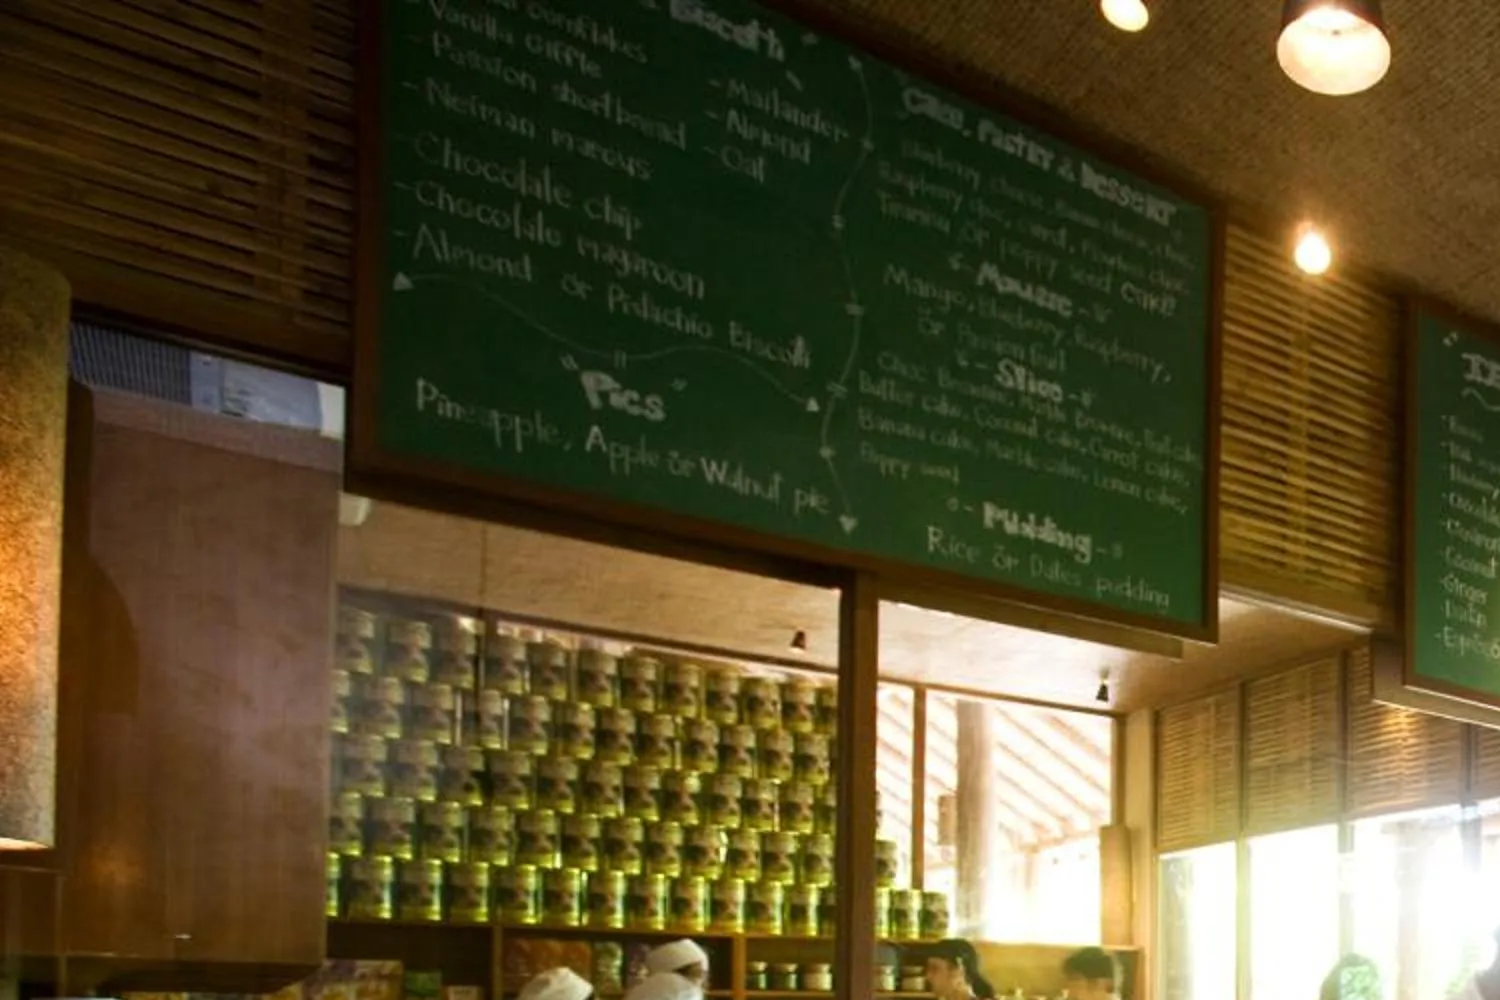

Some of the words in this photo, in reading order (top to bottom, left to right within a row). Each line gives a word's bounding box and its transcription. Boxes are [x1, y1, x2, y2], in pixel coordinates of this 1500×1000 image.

[726, 106, 812, 166] Almond
[415, 130, 573, 209] Chocolate
[584, 194, 643, 240] chip
[415, 180, 563, 248] Chocolate
[412, 223, 533, 283] Almond
[607, 284, 715, 341] Pistachio
[579, 369, 668, 423] Pies
[584, 424, 660, 477] Apple
[700, 455, 785, 506] Walnut
[793, 487, 832, 518] pie
[926, 523, 981, 565] Rice
[1096, 575, 1170, 610] pudding
[982, 500, 1093, 565] Pudding
[1443, 572, 1489, 605] Ginger
